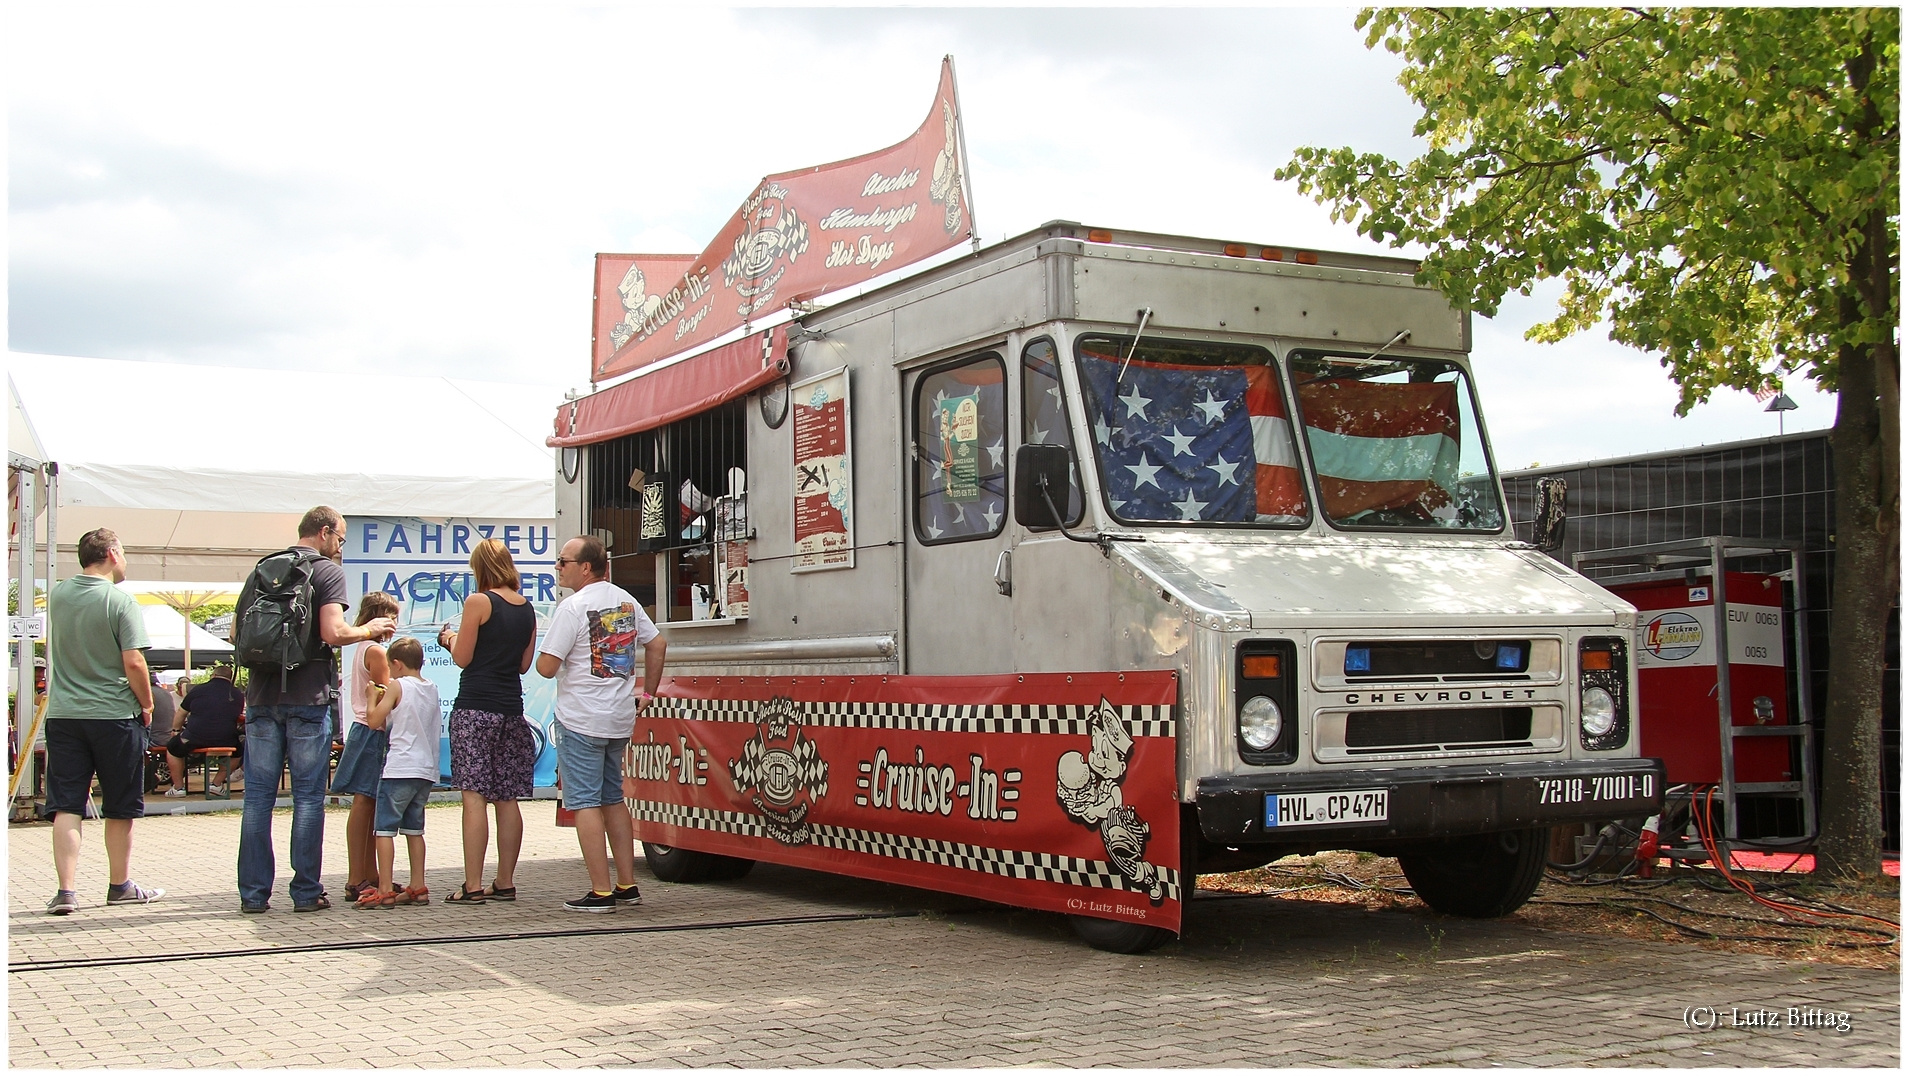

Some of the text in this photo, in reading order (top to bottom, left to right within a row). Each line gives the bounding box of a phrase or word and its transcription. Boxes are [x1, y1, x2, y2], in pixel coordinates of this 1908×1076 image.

[861, 168, 920, 197] Nachos
[820, 203, 918, 233] Hamburger
[825, 235, 894, 270] Hot Dogs
[1728, 610, 1778, 626] EUV 0063
[1745, 646, 1767, 659] 0053
[1345, 690, 1535, 705] CHEVROLET
[768, 722, 788, 739] Food
[871, 748, 998, 820] Cruise-In
[1539, 774, 1653, 804] 7218-7001-0
[752, 798, 807, 823] American Diner
[1279, 793, 1385, 822] HVL CP 47H
[767, 823, 809, 844] since 1996
